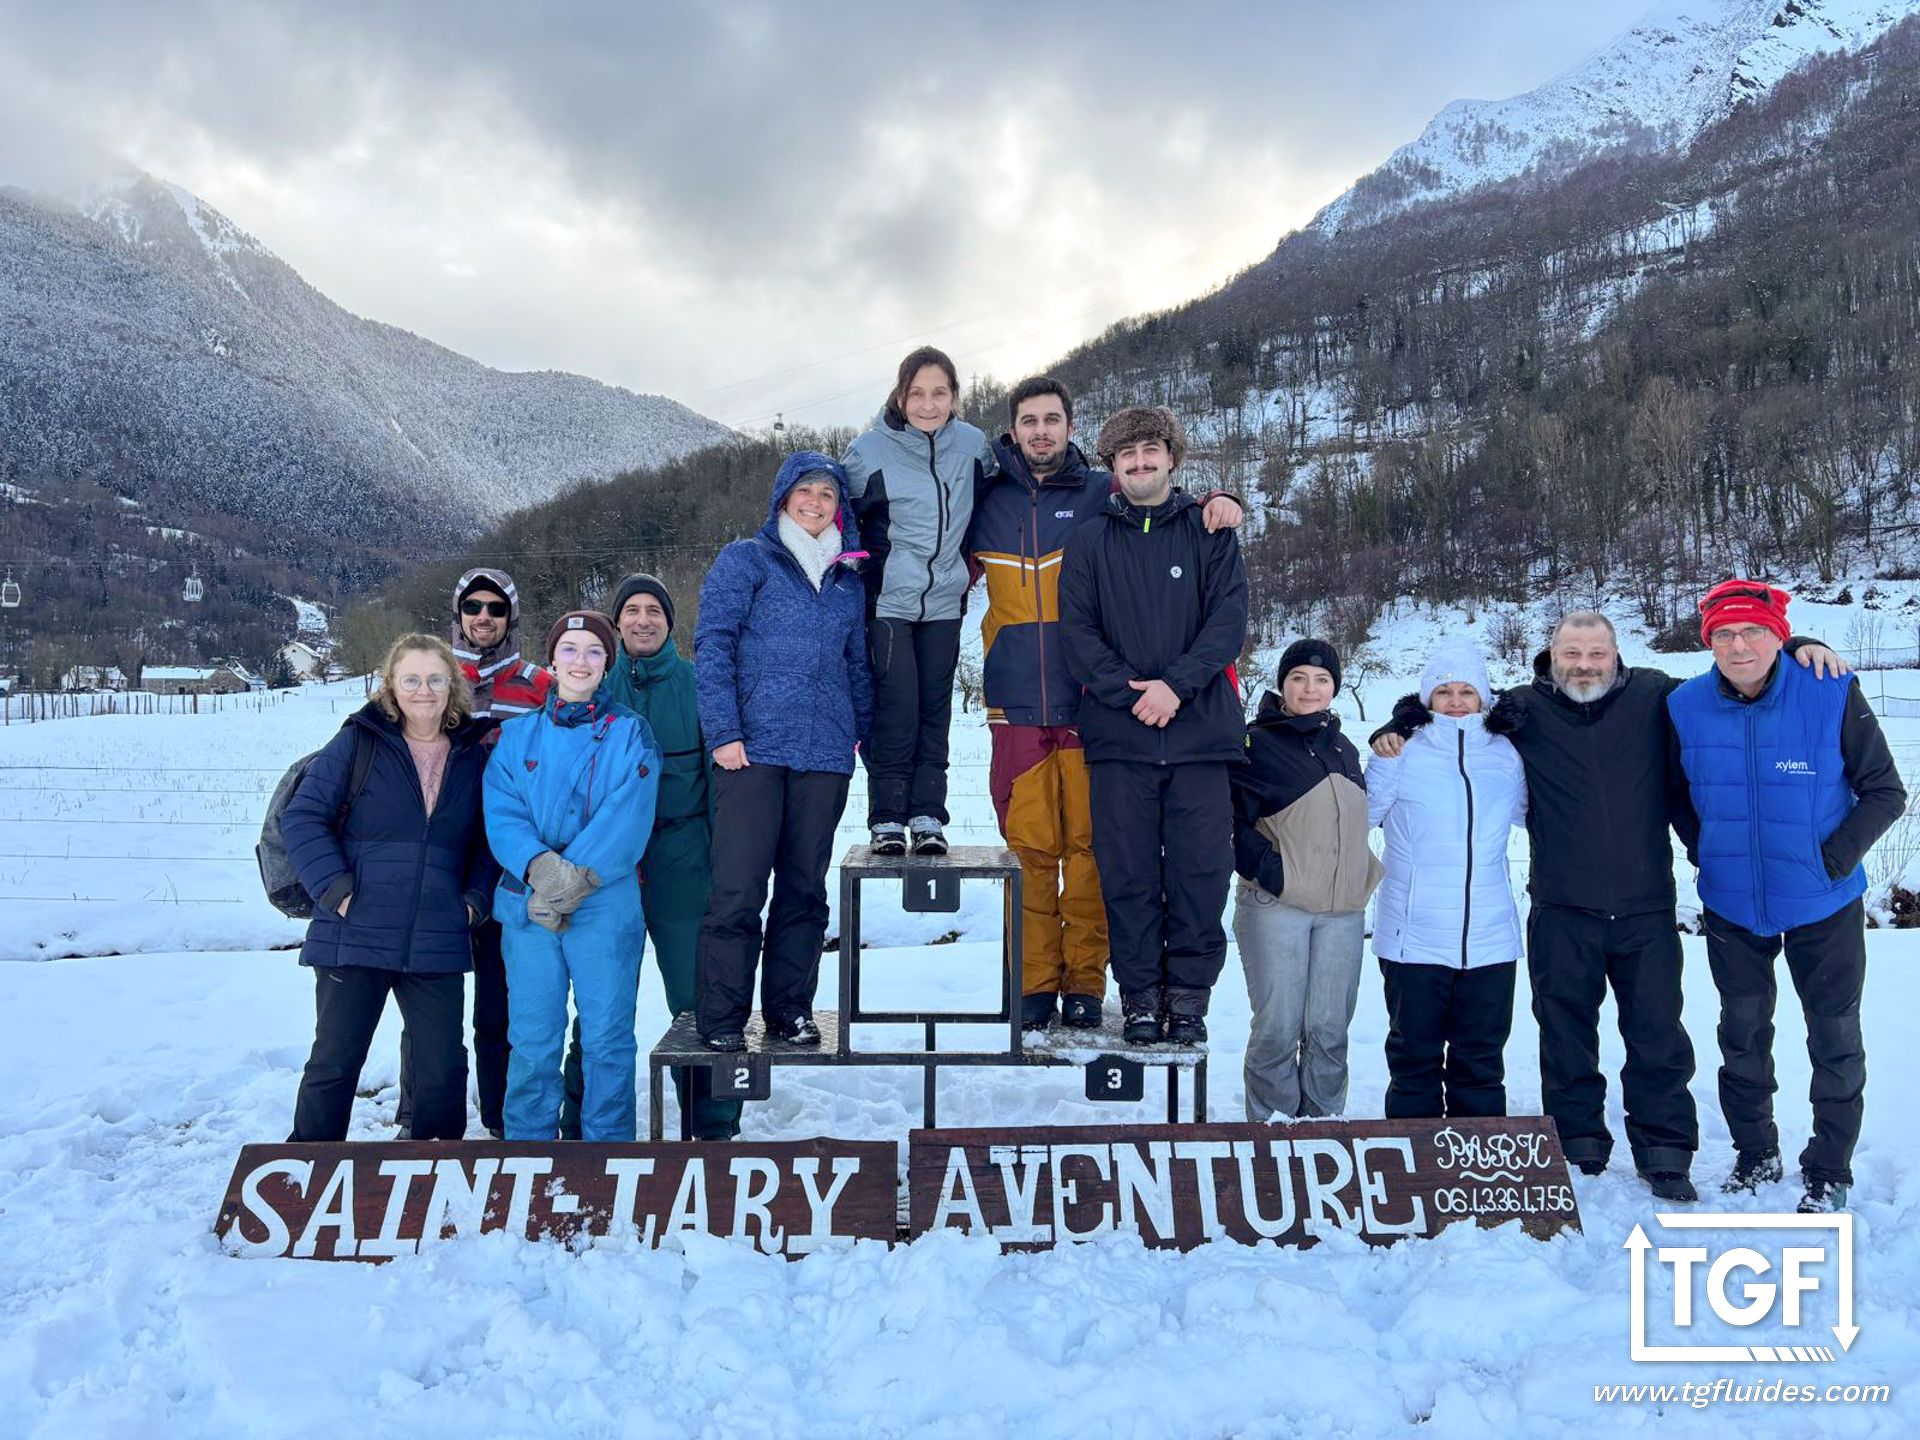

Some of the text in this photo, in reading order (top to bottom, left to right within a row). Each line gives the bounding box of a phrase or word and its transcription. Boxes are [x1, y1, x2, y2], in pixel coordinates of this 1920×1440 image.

[927, 879, 937, 900] 1
[734, 1068, 750, 1089] 2
[1107, 1068, 1122, 1089] 3
[1433, 1126, 1551, 1170] PARK
[930, 1137, 1428, 1243] AVENTURE
